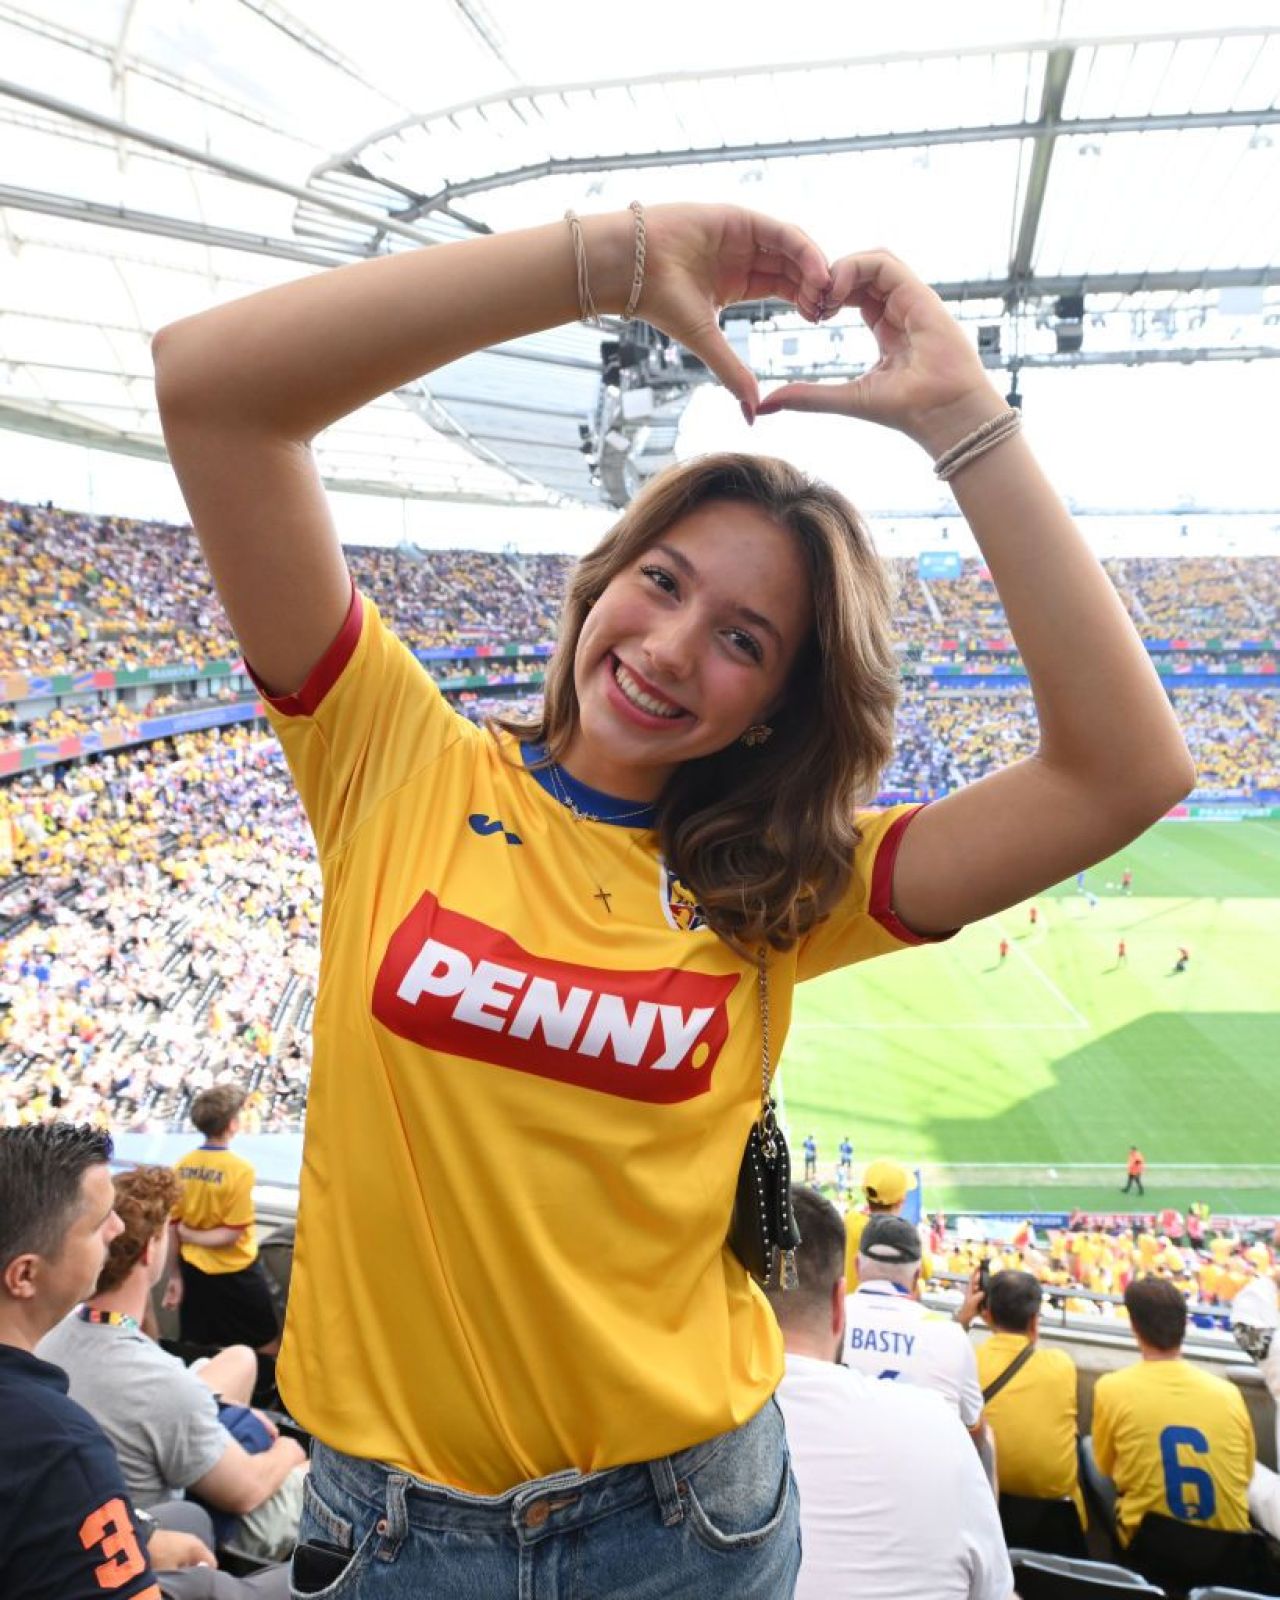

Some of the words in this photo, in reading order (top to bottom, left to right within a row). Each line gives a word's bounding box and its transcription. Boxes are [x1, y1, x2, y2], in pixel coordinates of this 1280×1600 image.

[851, 1327, 915, 1356] BASTY
[1159, 1425, 1216, 1520] 6
[79, 1497, 146, 1588] 3
